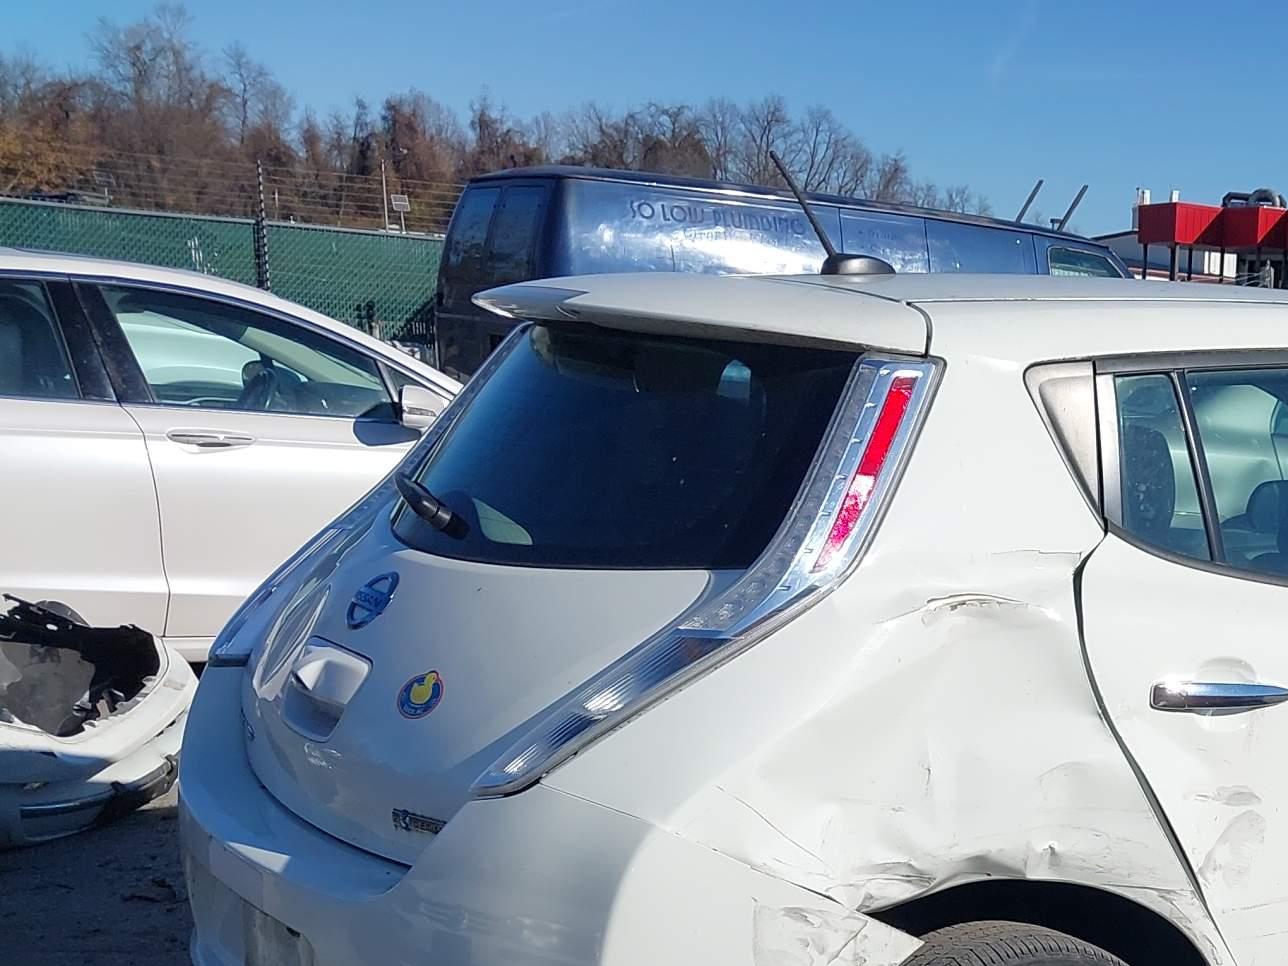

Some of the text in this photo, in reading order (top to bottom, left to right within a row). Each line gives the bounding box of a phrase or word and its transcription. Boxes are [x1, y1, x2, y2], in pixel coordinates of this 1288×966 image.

[629, 200, 807, 235] SO LOW PLUMBING
